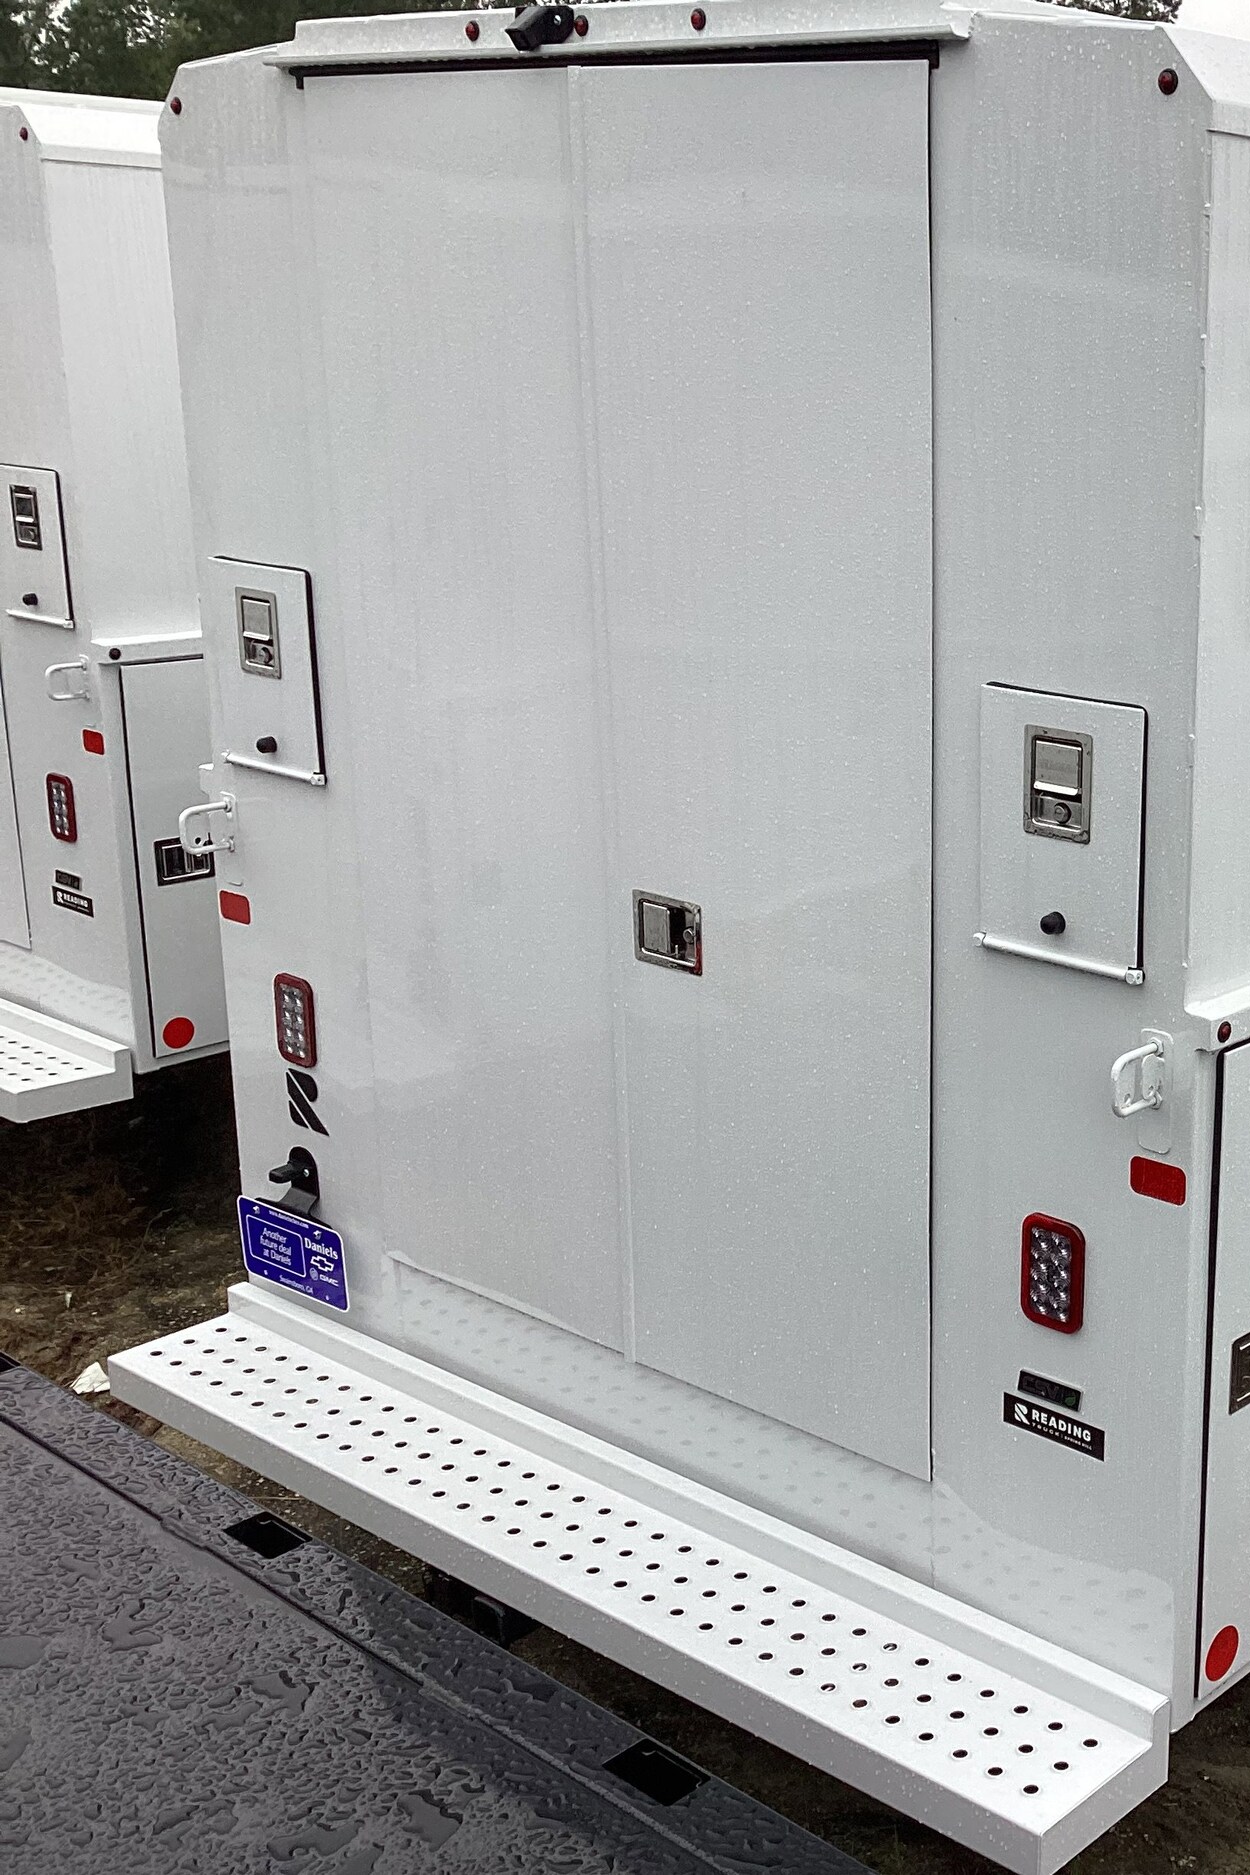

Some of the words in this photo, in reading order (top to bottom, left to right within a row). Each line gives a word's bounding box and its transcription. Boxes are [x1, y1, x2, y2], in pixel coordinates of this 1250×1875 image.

[259, 1234, 278, 1251] future
[278, 1243, 292, 1256] deal
[262, 1227, 287, 1244] Another
[263, 1248, 270, 1258] at
[270, 1249, 292, 1266] Daniels
[304, 1237, 339, 1260] Daniels
[319, 1273, 339, 1287] GMC
[1031, 1408, 1092, 1442] READING
